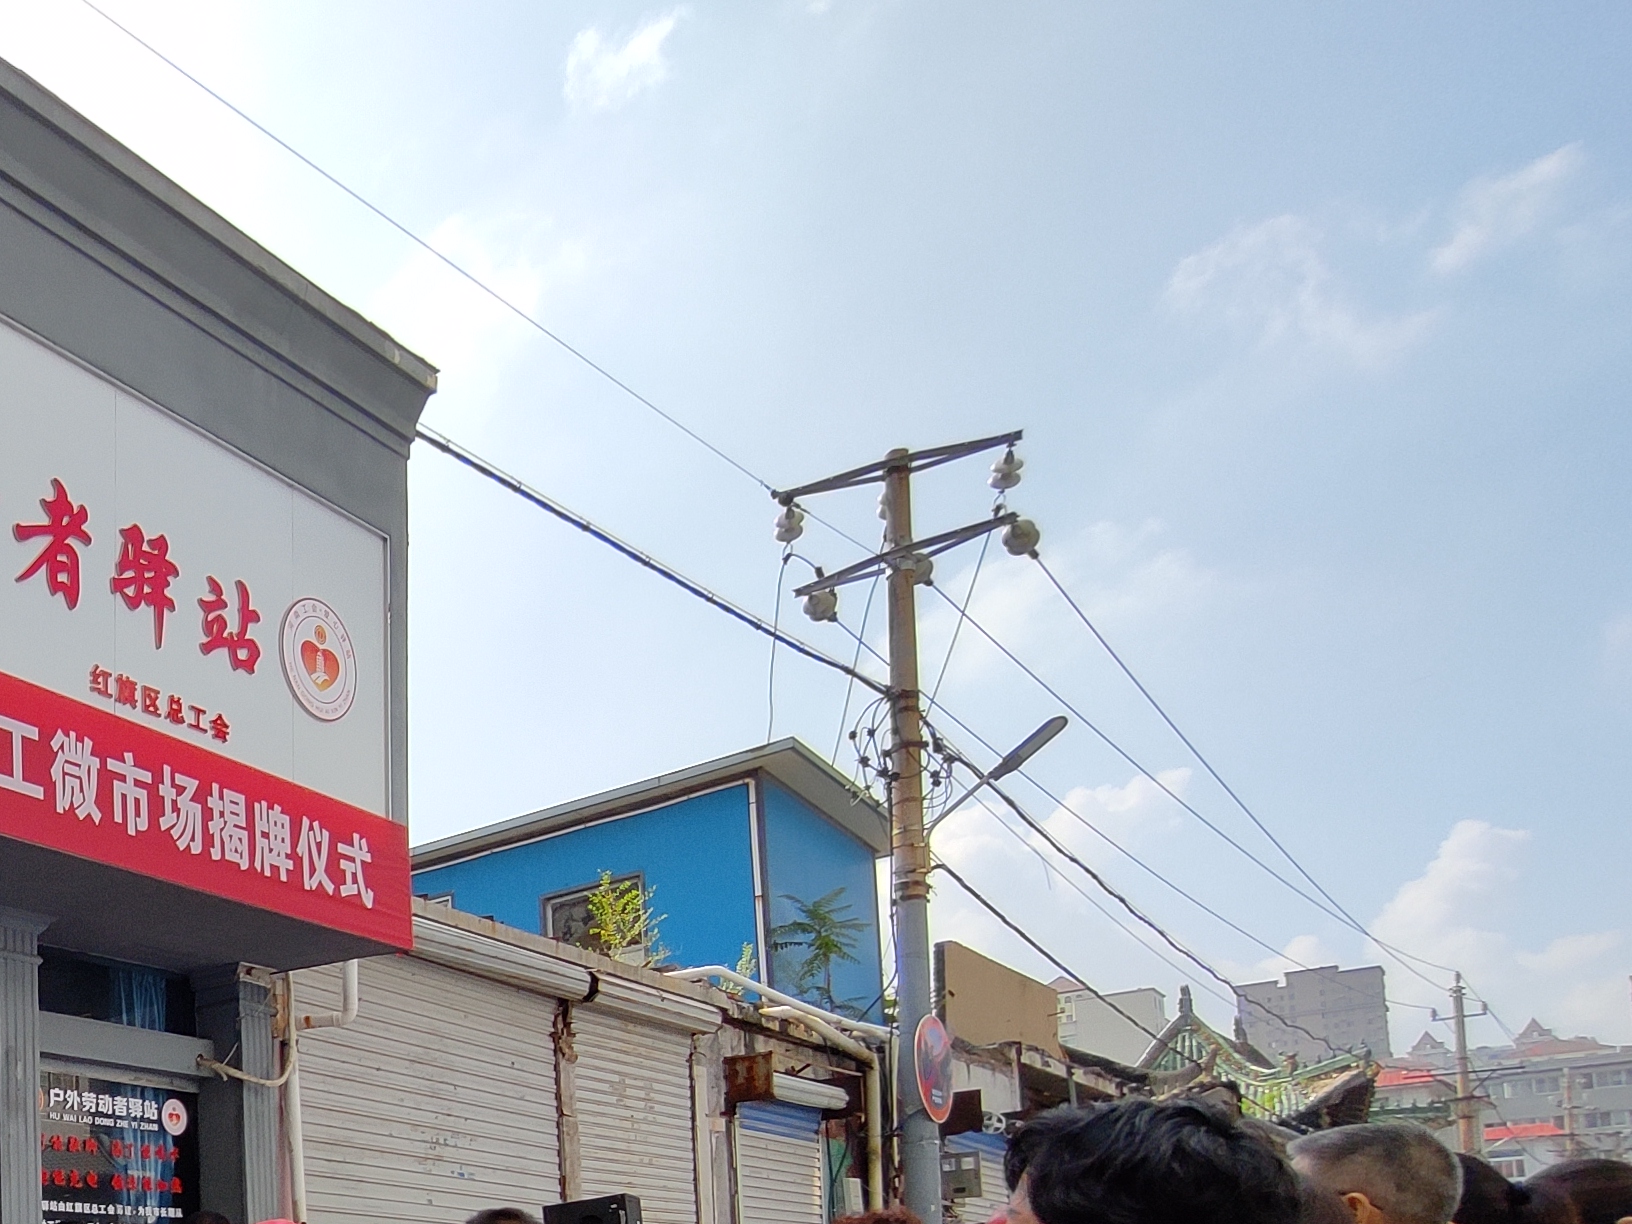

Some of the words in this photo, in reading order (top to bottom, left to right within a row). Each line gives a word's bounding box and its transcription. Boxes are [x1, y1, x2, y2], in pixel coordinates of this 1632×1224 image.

[89, 663, 230, 744] 红旗区总工会
[49, 1087, 159, 1121] 户外劳动者驿站
[49, 1113, 61, 1121] HU
[62, 1114, 77, 1123] WAI
[78, 1115, 93, 1125] LAO
[94, 1117, 115, 1127] DONG
[115, 1119, 129, 1129] ZHE
[131, 1120, 139, 1130] YI
[139, 1121, 159, 1132] ZHAN
